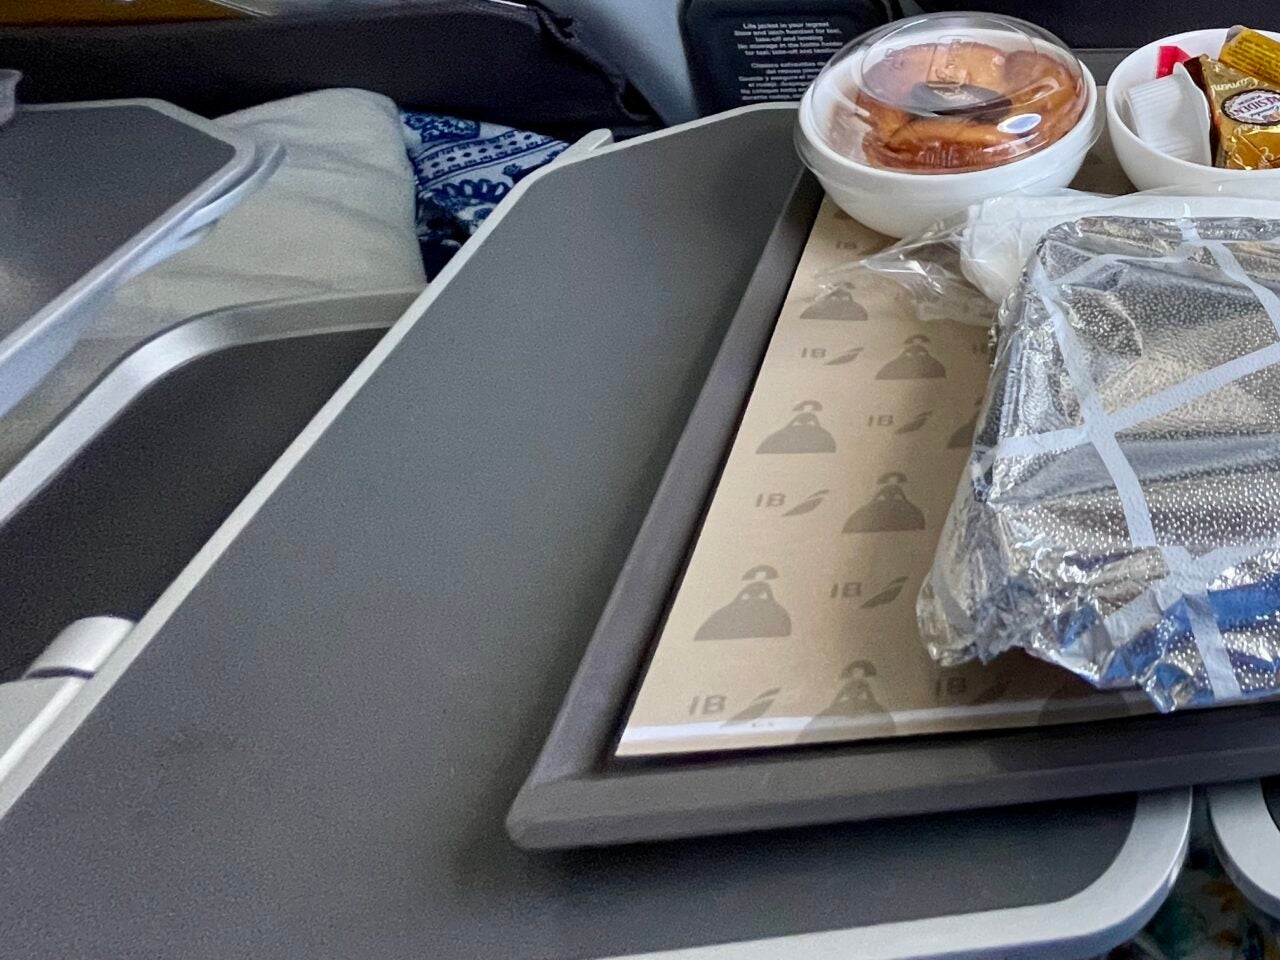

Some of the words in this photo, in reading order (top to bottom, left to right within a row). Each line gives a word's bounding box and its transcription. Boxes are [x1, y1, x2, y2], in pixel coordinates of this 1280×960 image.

[801, 347, 827, 359] IB
[867, 414, 894, 428] IB
[756, 493, 786, 508] IB
[829, 582, 862, 599] IB
[935, 676, 967, 697] IB
[688, 694, 728, 716] IB
